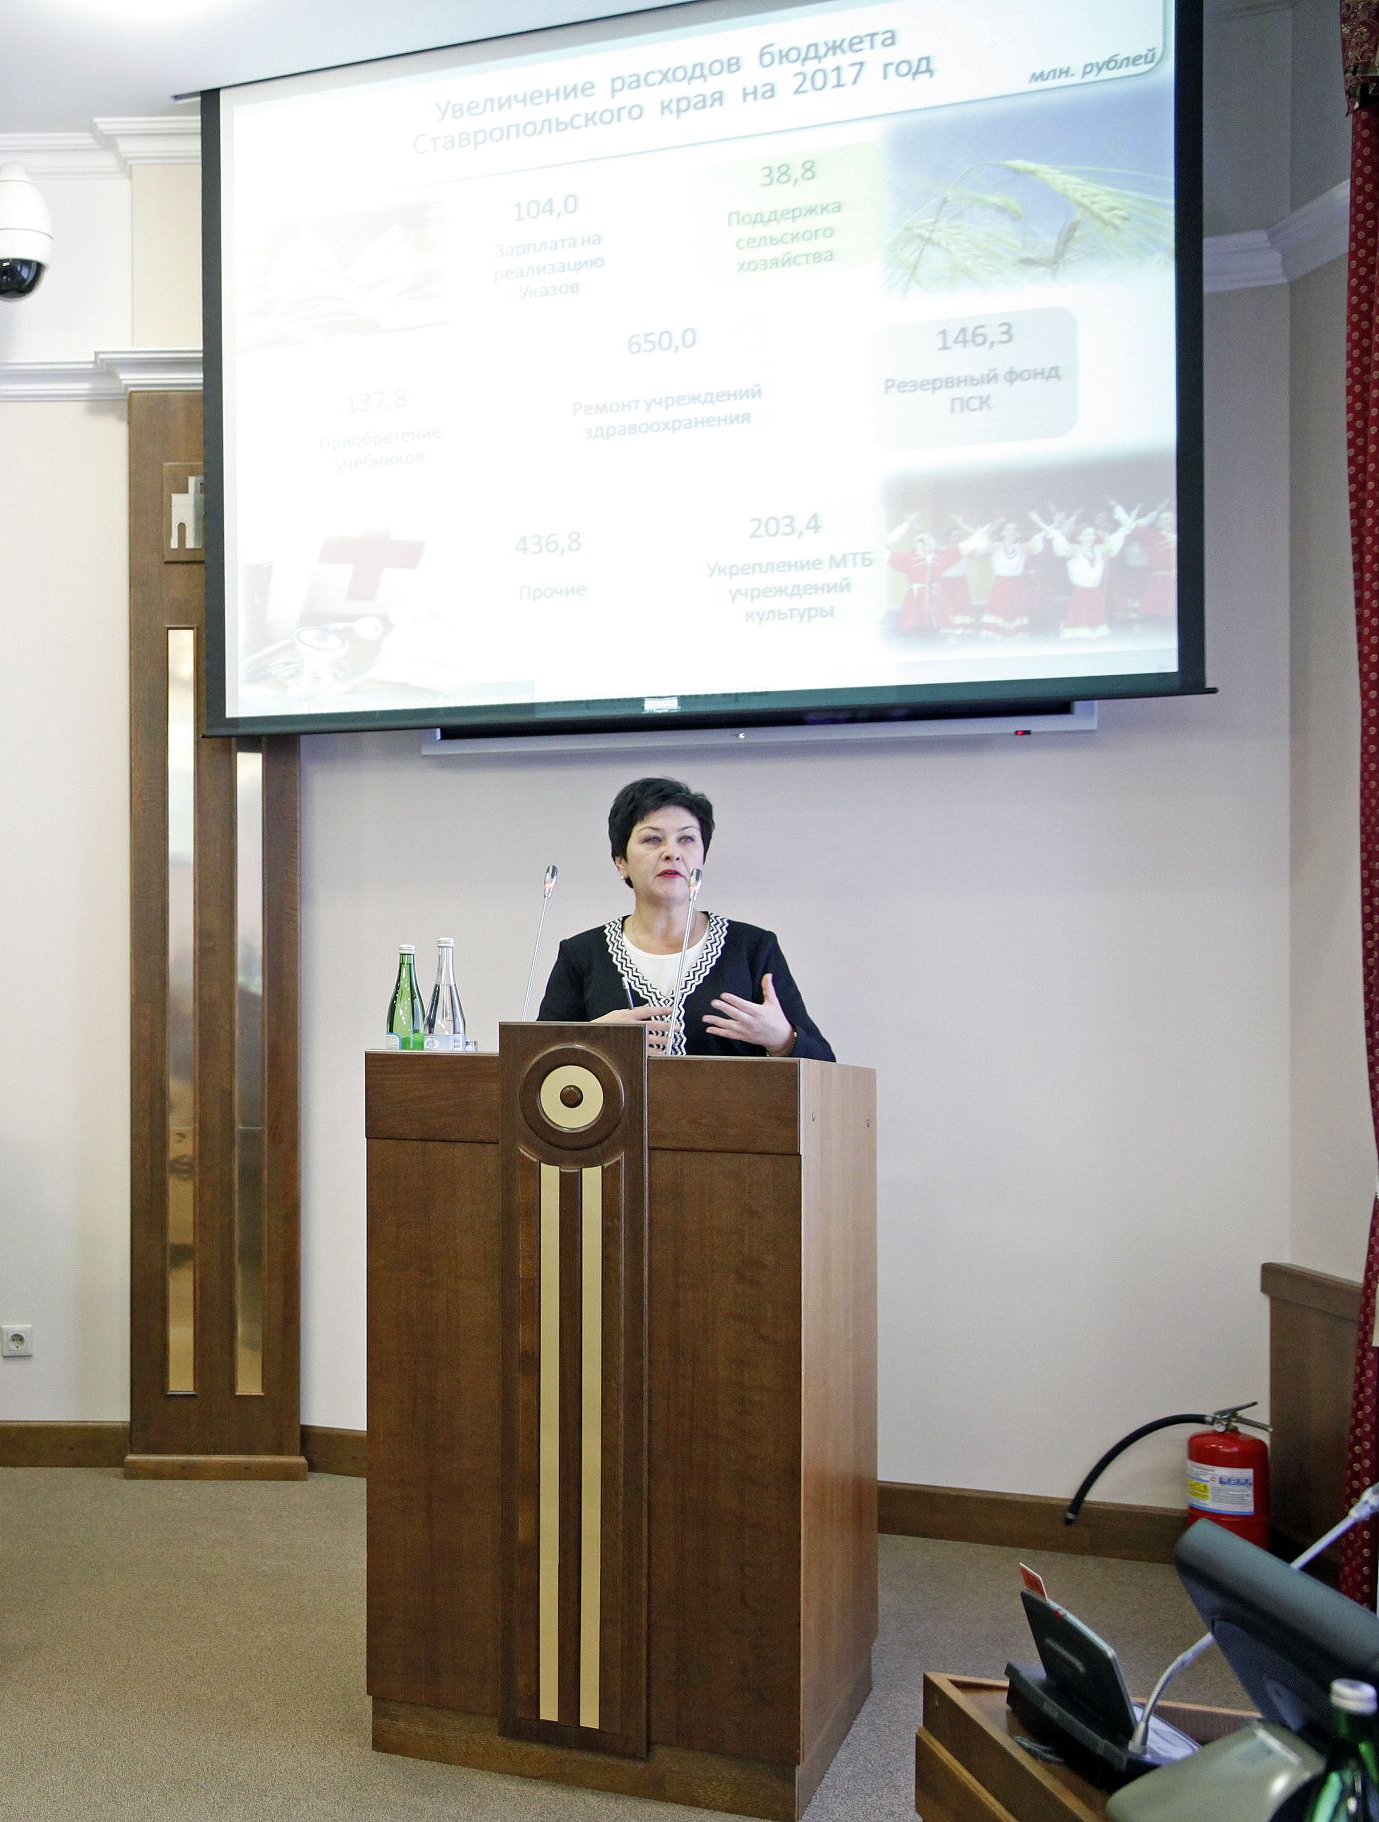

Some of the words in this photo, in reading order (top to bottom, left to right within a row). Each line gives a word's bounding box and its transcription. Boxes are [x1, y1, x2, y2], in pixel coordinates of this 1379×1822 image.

[435, 80, 596, 122] Увеличение
[610, 55, 742, 98] расходов
[758, 28, 898, 68] бюджета
[1028, 65, 1075, 84] млн.
[1081, 47, 1157, 79] рублей
[413, 103, 644, 154] Ставропольского
[659, 89, 724, 119] края
[741, 81, 776, 104] на
[792, 60, 866, 96] 2017
[881, 55, 935, 81] год
[759, 159, 817, 188] 38,8
[512, 193, 580, 222] 104,0
[727, 200, 843, 228] Поддержка
[494, 236, 578, 260] Зарплата
[580, 233, 604, 248] на
[735, 226, 835, 250] сельского
[493, 256, 606, 284] реализацию
[736, 249, 835, 273] хозяйства
[627, 327, 698, 355] 650,0
[936, 321, 1015, 351] 146,3
[883, 368, 999, 394] Резервный
[1003, 365, 1062, 387] фонд
[572, 399, 641, 417] Ремонт
[643, 383, 764, 414] учреждений
[949, 394, 992, 414] ПСК
[583, 411, 752, 441] здравоохранения
[748, 512, 822, 540] 203,4
[514, 531, 582, 557] 436,8
[705, 557, 823, 580] Укрепление
[827, 551, 874, 570] МТБ
[518, 584, 588, 604] Прочие
[728, 576, 852, 604] учреждений
[744, 605, 835, 625] культуры
